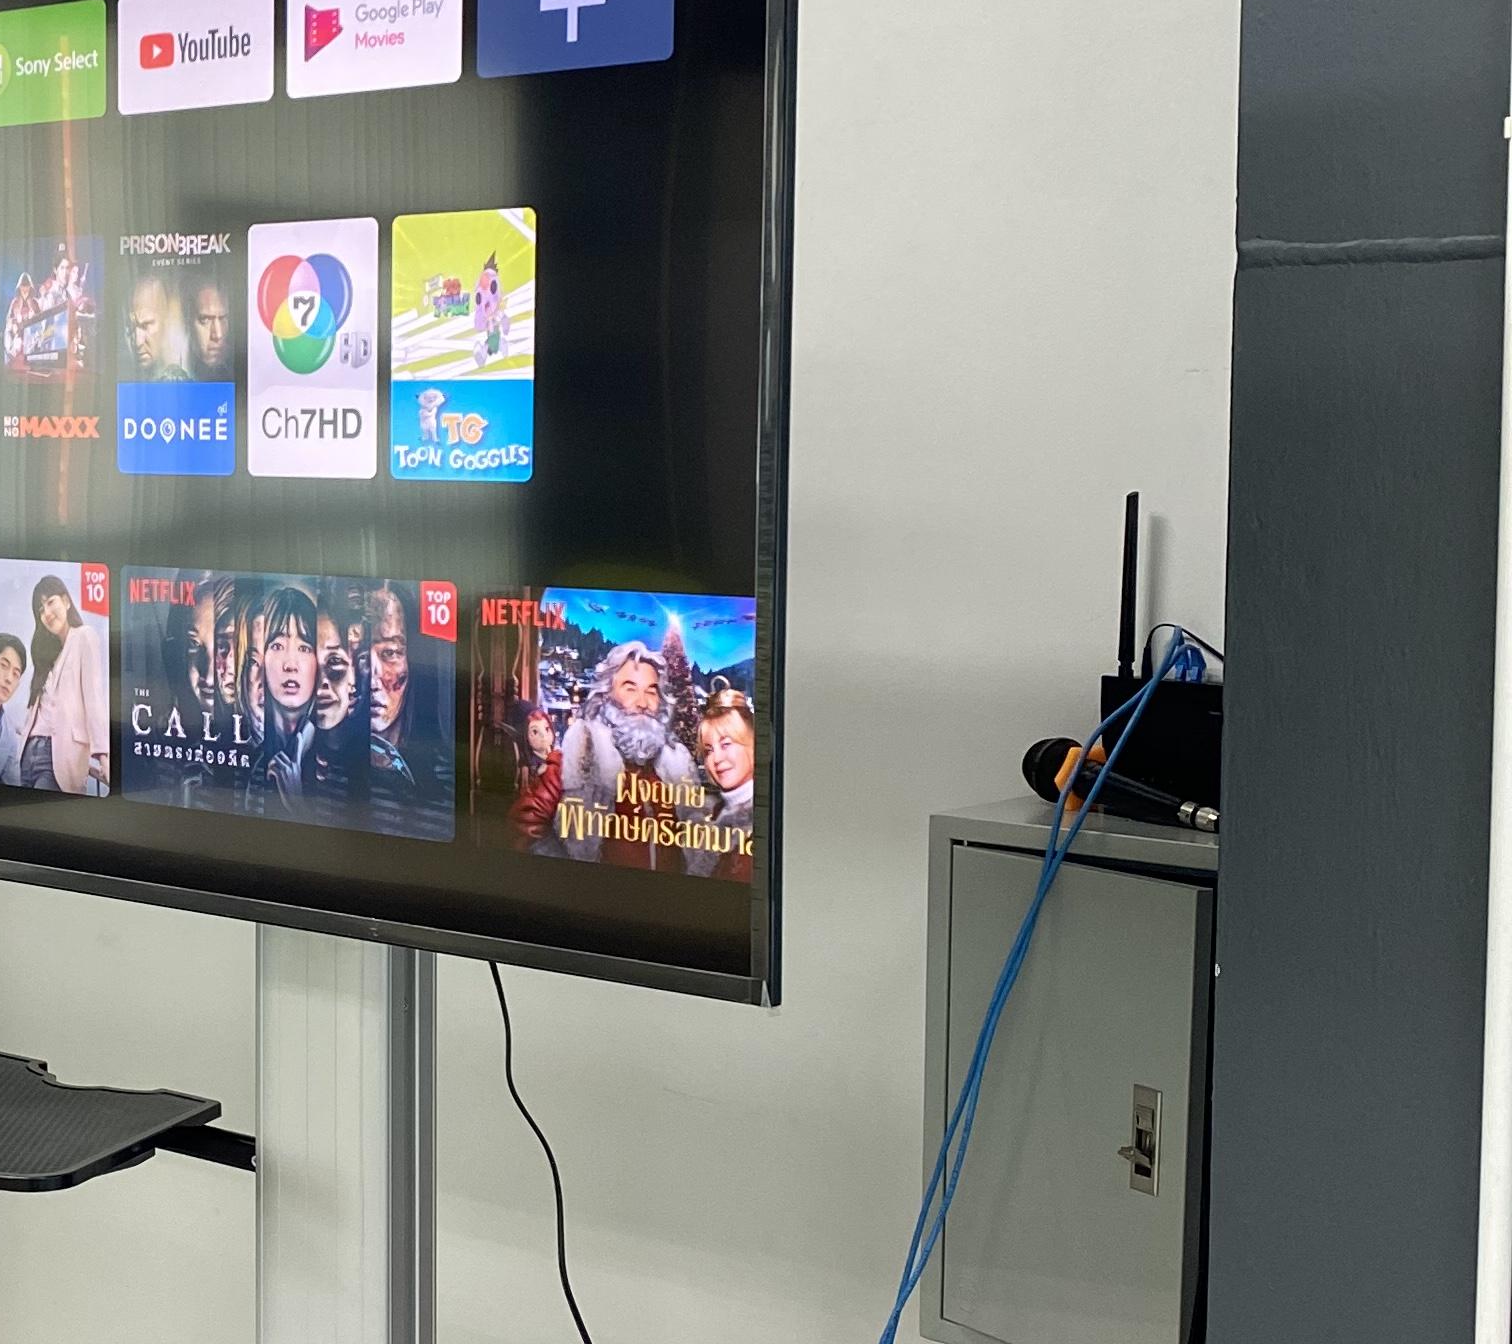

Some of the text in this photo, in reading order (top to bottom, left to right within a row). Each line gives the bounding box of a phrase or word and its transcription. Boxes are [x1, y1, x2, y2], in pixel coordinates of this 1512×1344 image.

[355, 0, 409, 24] Google
[178, 26, 251, 63] YouTube
[355, 29, 405, 50] Movies
[15, 49, 99, 77] Sony Select
[20, 416, 100, 438] MAXXX
[261, 407, 363, 439] Ch7HD
[441, 412, 488, 445] TG
[394, 445, 530, 470] TOON GOGGLES
[85, 572, 105, 583] TOP
[86, 583, 105, 602] 10
[129, 578, 196, 606] NETFLIX
[426, 590, 451, 603] TOP
[428, 604, 450, 625] 10
[481, 598, 566, 631] NETFLIX
[131, 704, 252, 745] CALL
